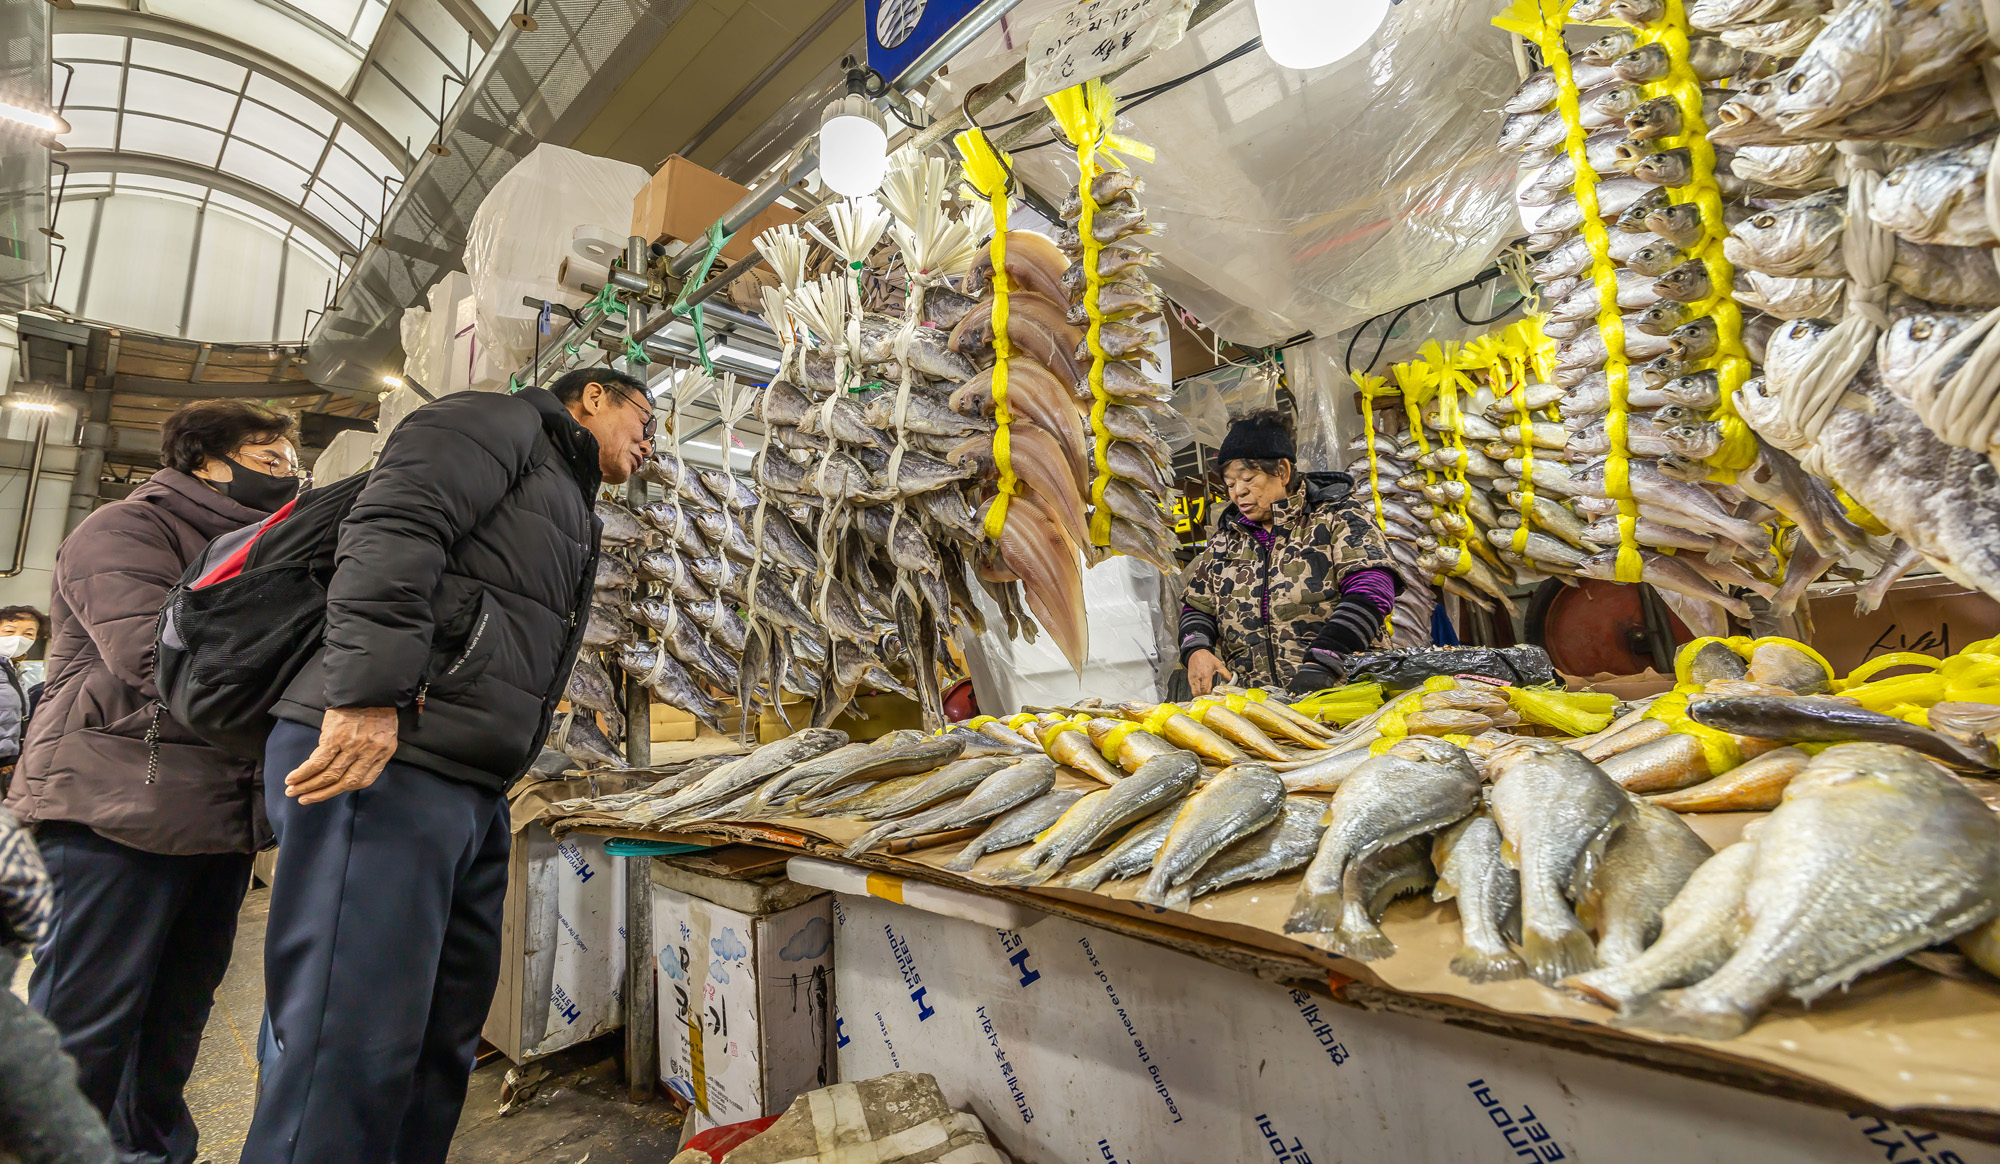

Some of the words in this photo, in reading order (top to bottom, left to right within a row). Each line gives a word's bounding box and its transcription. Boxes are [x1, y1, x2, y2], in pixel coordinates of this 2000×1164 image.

[567, 843, 586, 866] STEEL
[884, 924, 920, 990] HYUNDAI
[892, 935, 922, 985] STEEL
[1078, 936, 1100, 968] steel
[1093, 968, 1108, 985] of
[554, 983, 572, 1007] STEEL
[1105, 984, 1120, 1006] era
[872, 1011, 889, 1038] steel
[1116, 1007, 1137, 1037] new
[882, 1038, 893, 1051] of
[1132, 1039, 1151, 1064] the
[888, 1051, 901, 1070] era
[1147, 1063, 1183, 1124] Leading
